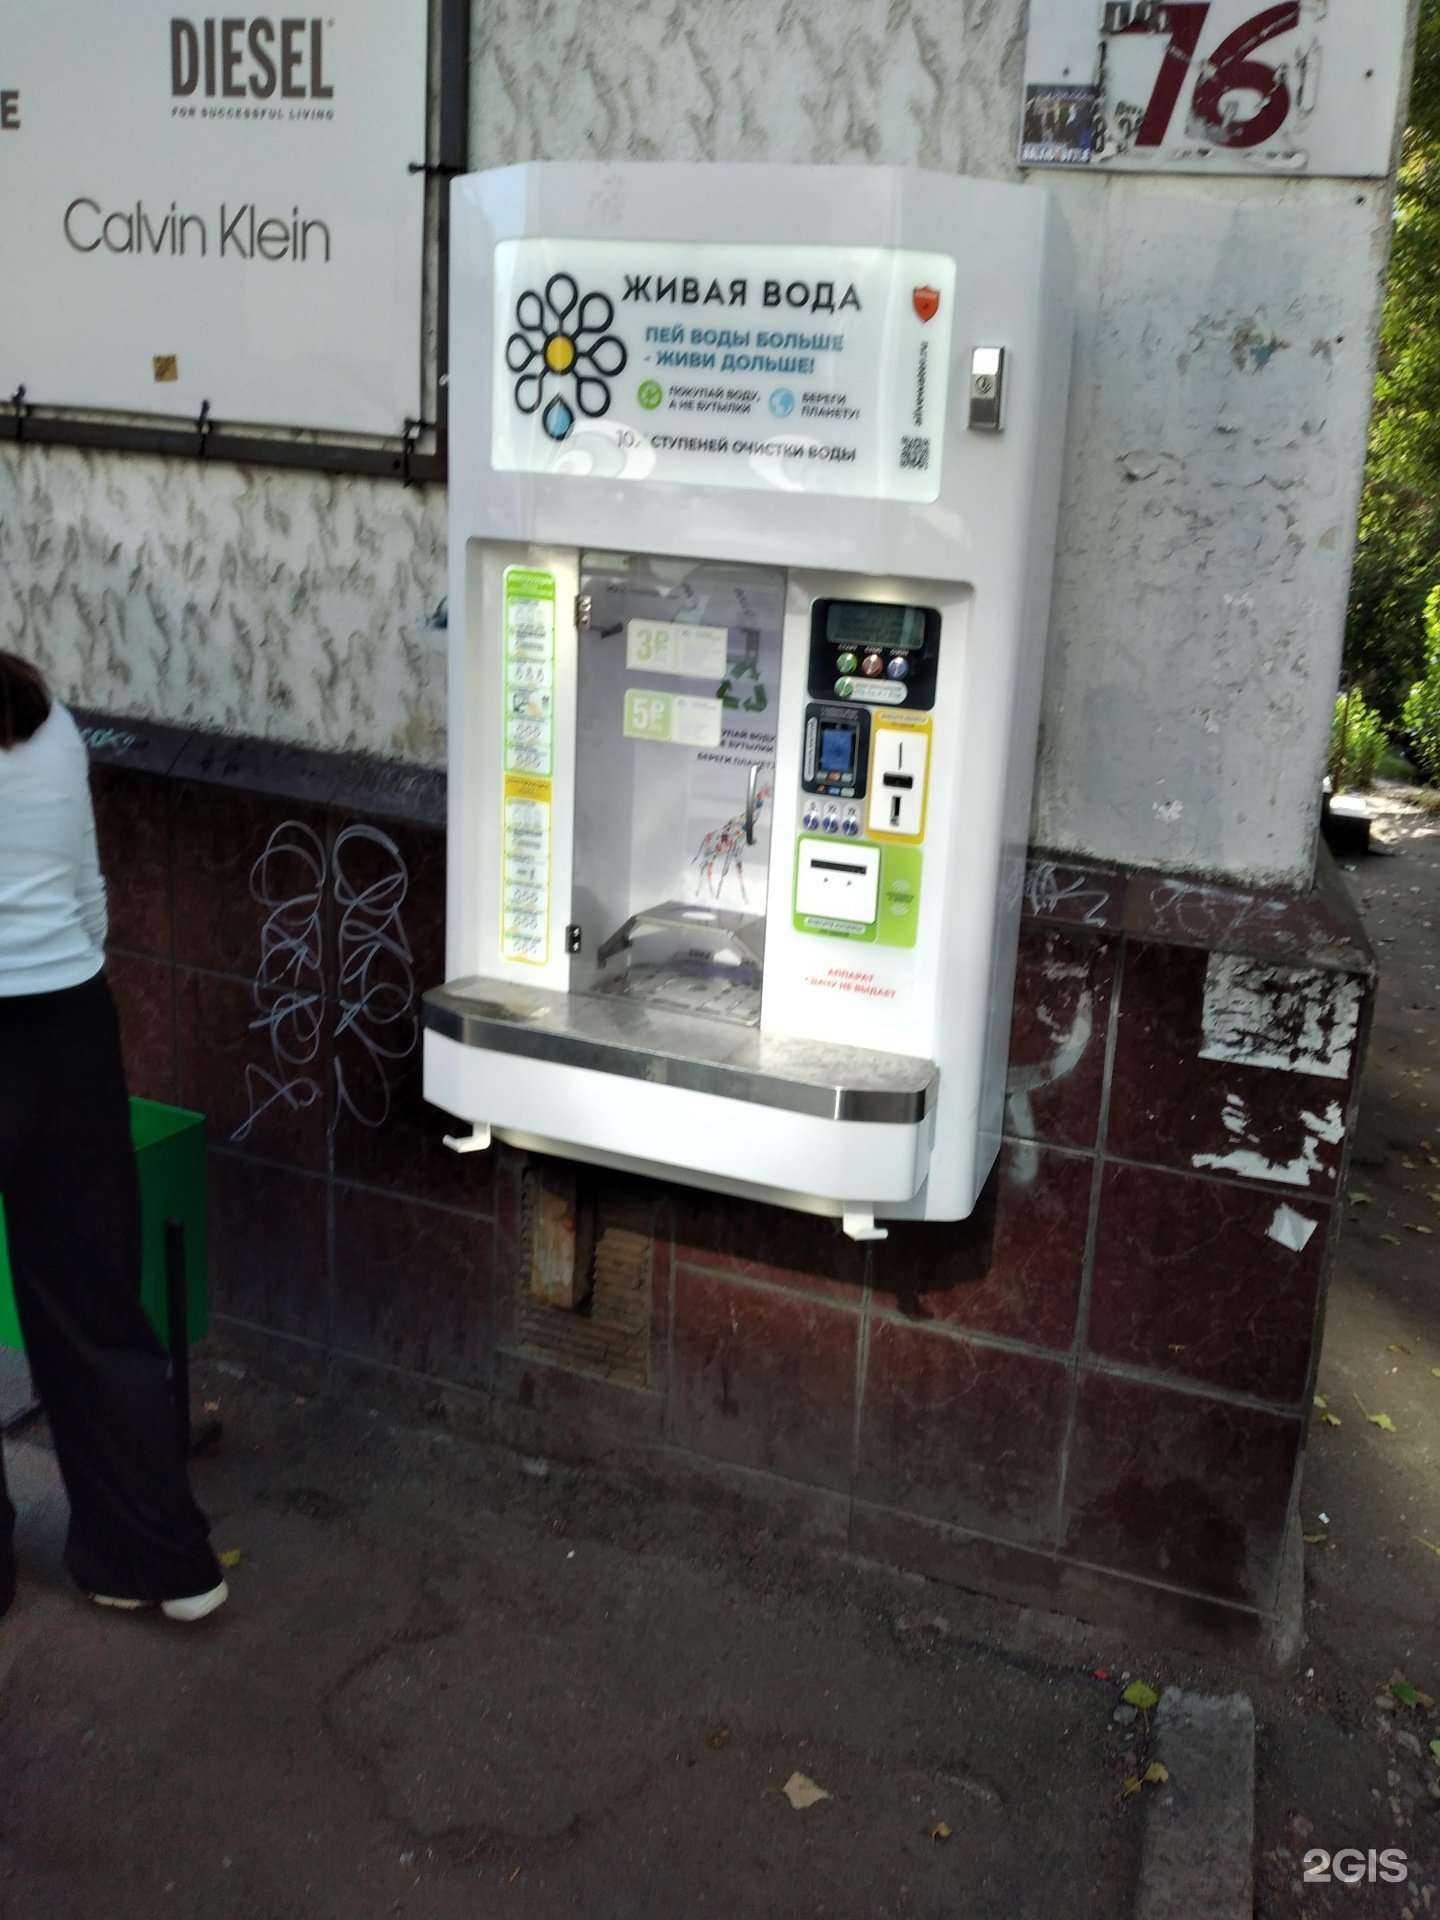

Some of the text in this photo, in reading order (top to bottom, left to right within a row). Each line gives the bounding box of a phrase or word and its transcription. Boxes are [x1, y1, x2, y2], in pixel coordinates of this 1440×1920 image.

[170, 17, 334, 99] DIESEL
[64, 197, 331, 263] Calvin Klein
[622, 273, 863, 314] ЖИВАЯ ВОДА
[645, 323, 845, 352] ПЕЙ ВОДЫ БОЛЬШЕ
[656, 350, 715, 369] ЖИВИ
[720, 352, 815, 375] ДОЛЬШЕ!
[650, 434, 729, 454] СТУПЕНЕЙ
[732, 440, 805, 459] ОЧИСТКИ
[808, 446, 857, 463] ВОДЫ
